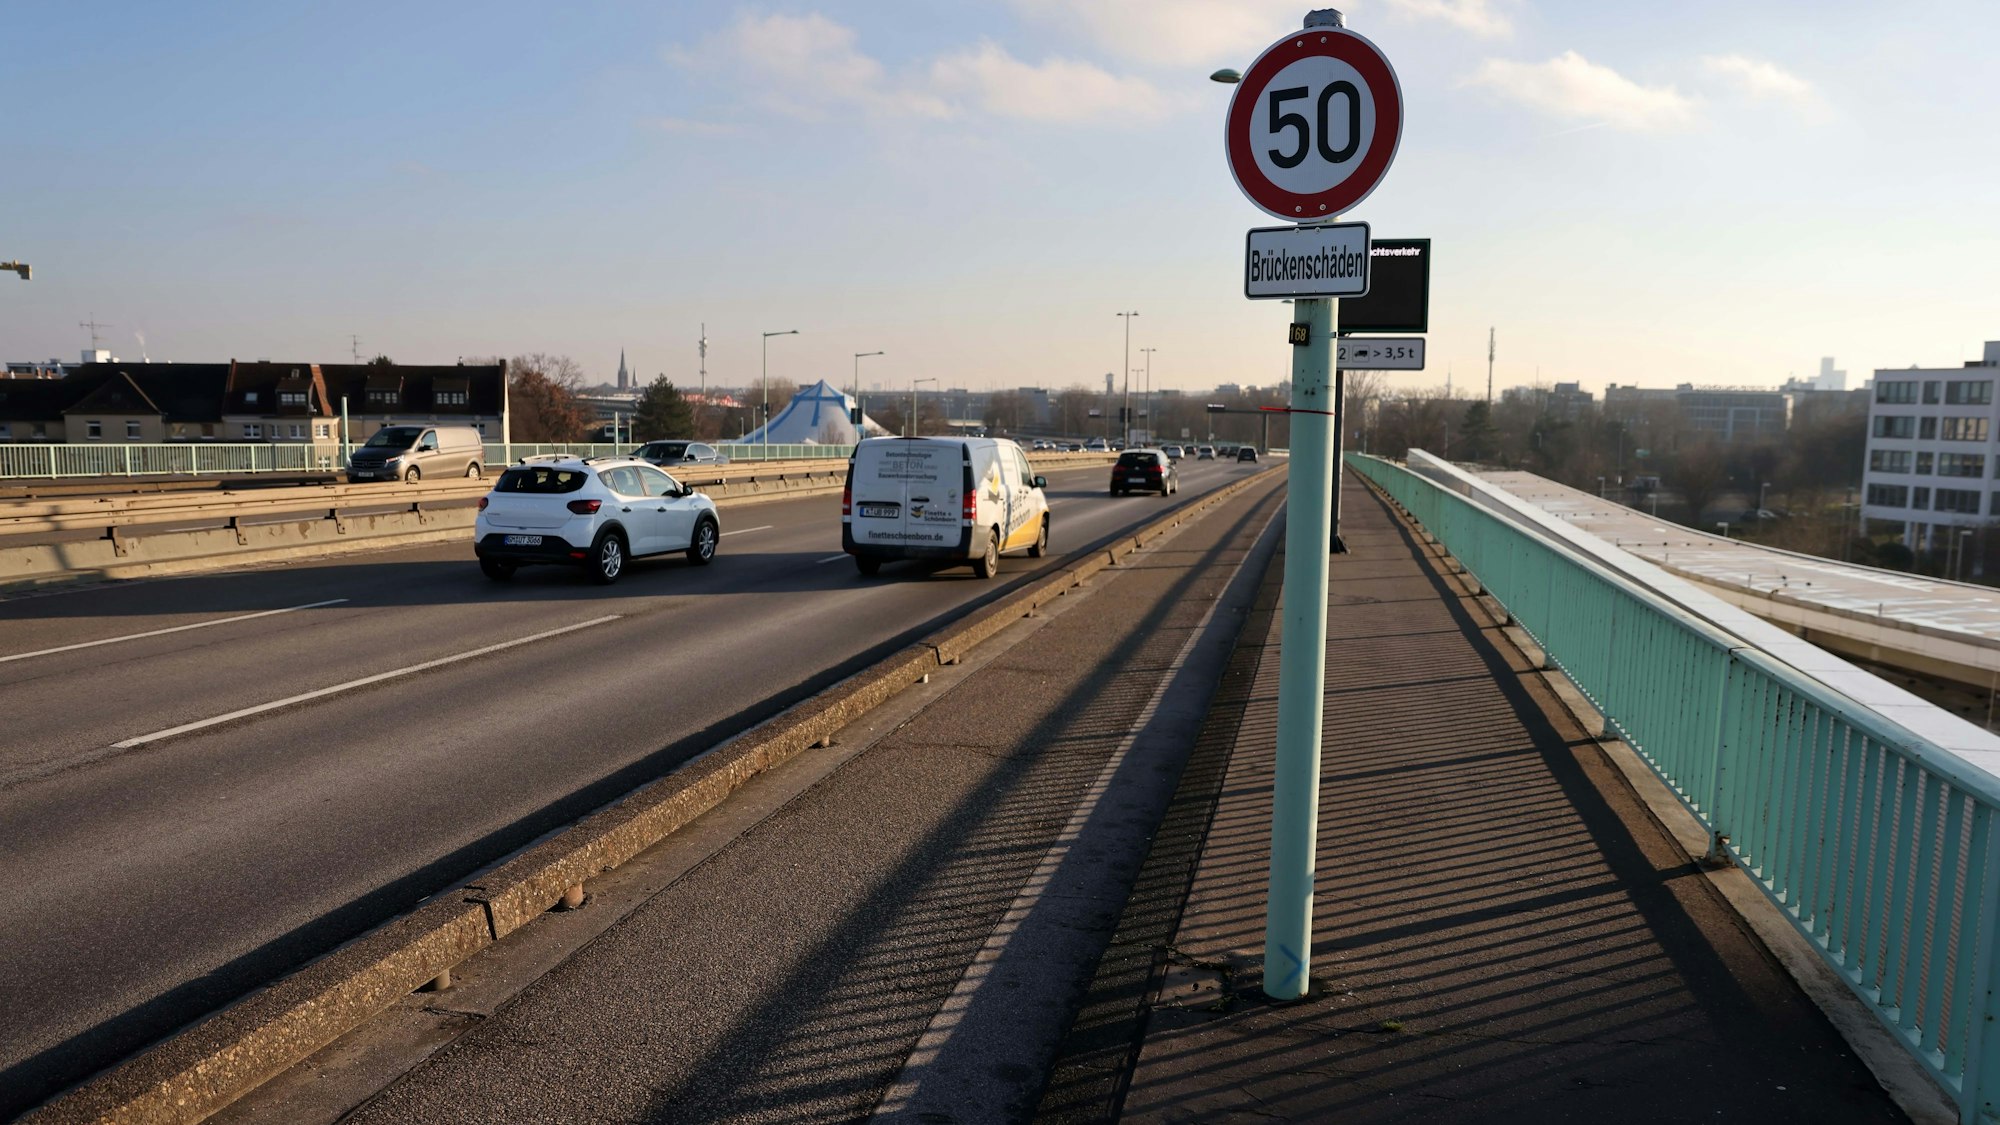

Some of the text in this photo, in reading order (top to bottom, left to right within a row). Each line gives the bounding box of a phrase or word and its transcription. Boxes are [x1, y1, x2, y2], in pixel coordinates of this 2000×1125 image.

[1268, 80, 1361, 169] 50
[1251, 245, 1363, 282] Brückenschäden
[1290, 327, 1306, 342] 168
[1385, 347, 1405, 360] 3,5
[1408, 348, 1415, 359] t
[893, 461, 923, 470] BETON
[868, 531, 944, 542] finetteschoenborn.de
